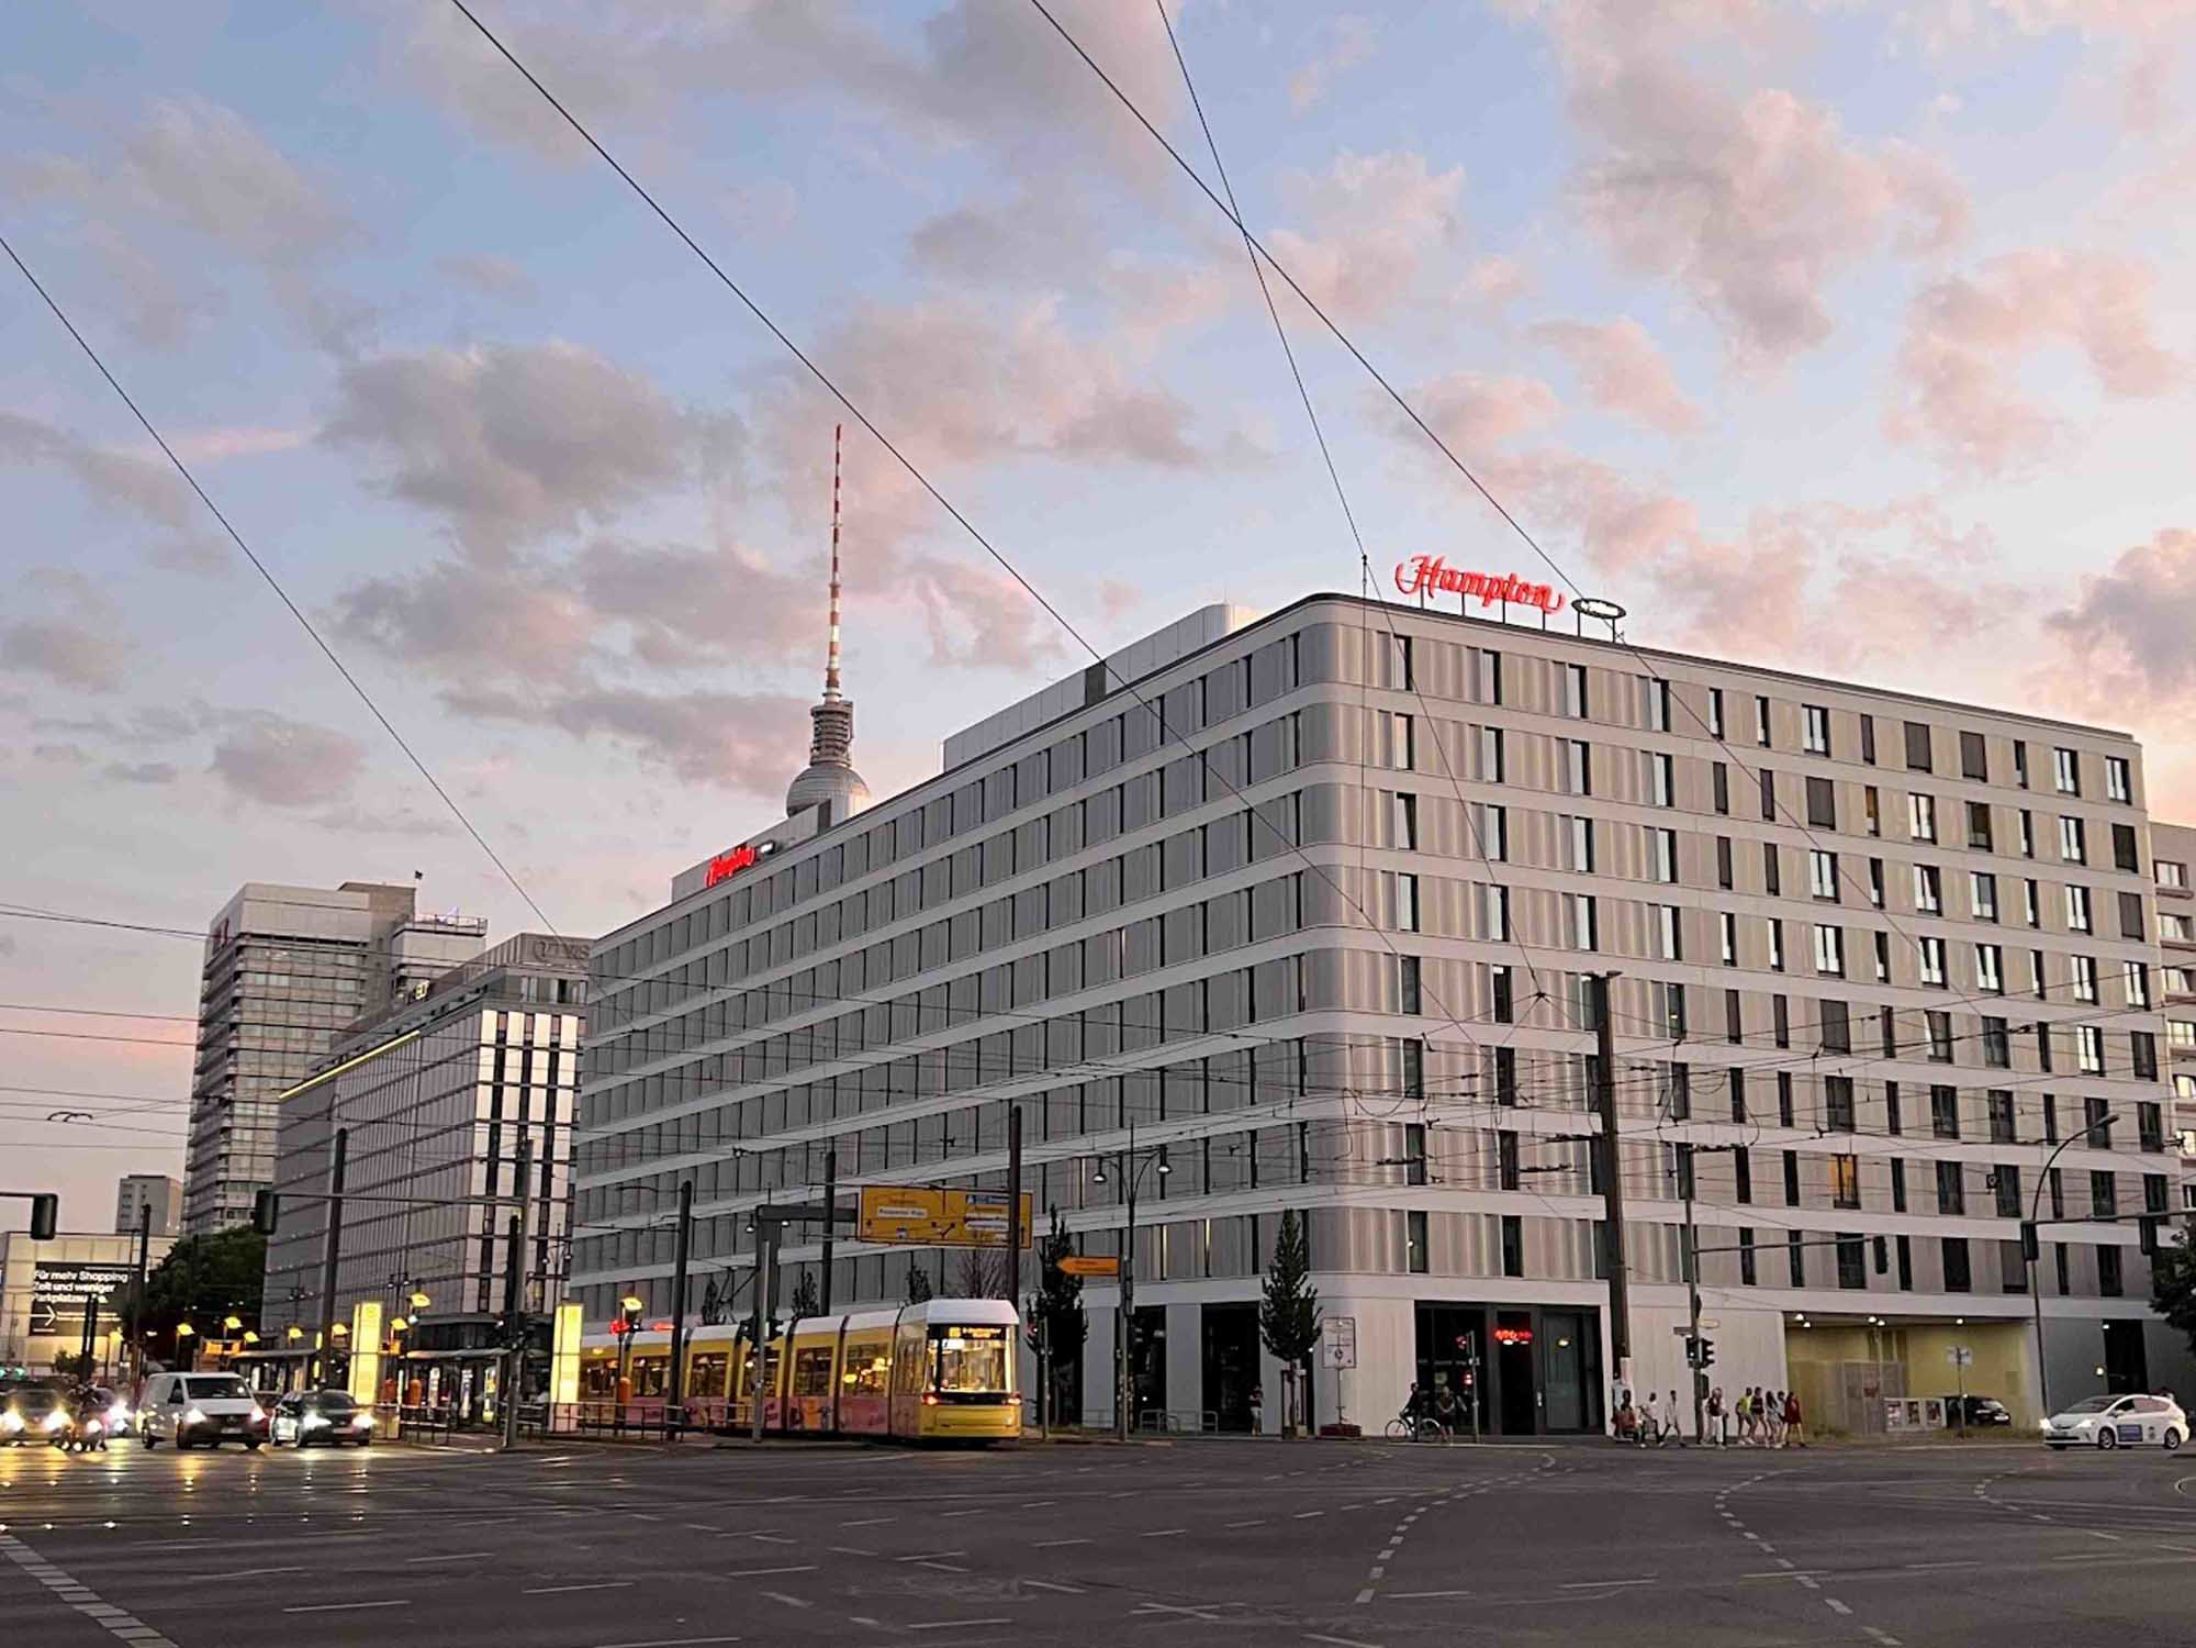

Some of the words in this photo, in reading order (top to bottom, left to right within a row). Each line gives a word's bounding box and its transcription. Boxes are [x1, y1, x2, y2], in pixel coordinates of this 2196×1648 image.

[1395, 554, 1565, 614] Hampton
[50, 1270, 78, 1280] mehr
[53, 1282, 73, 1291] und
[74, 1283, 116, 1293] weniger
